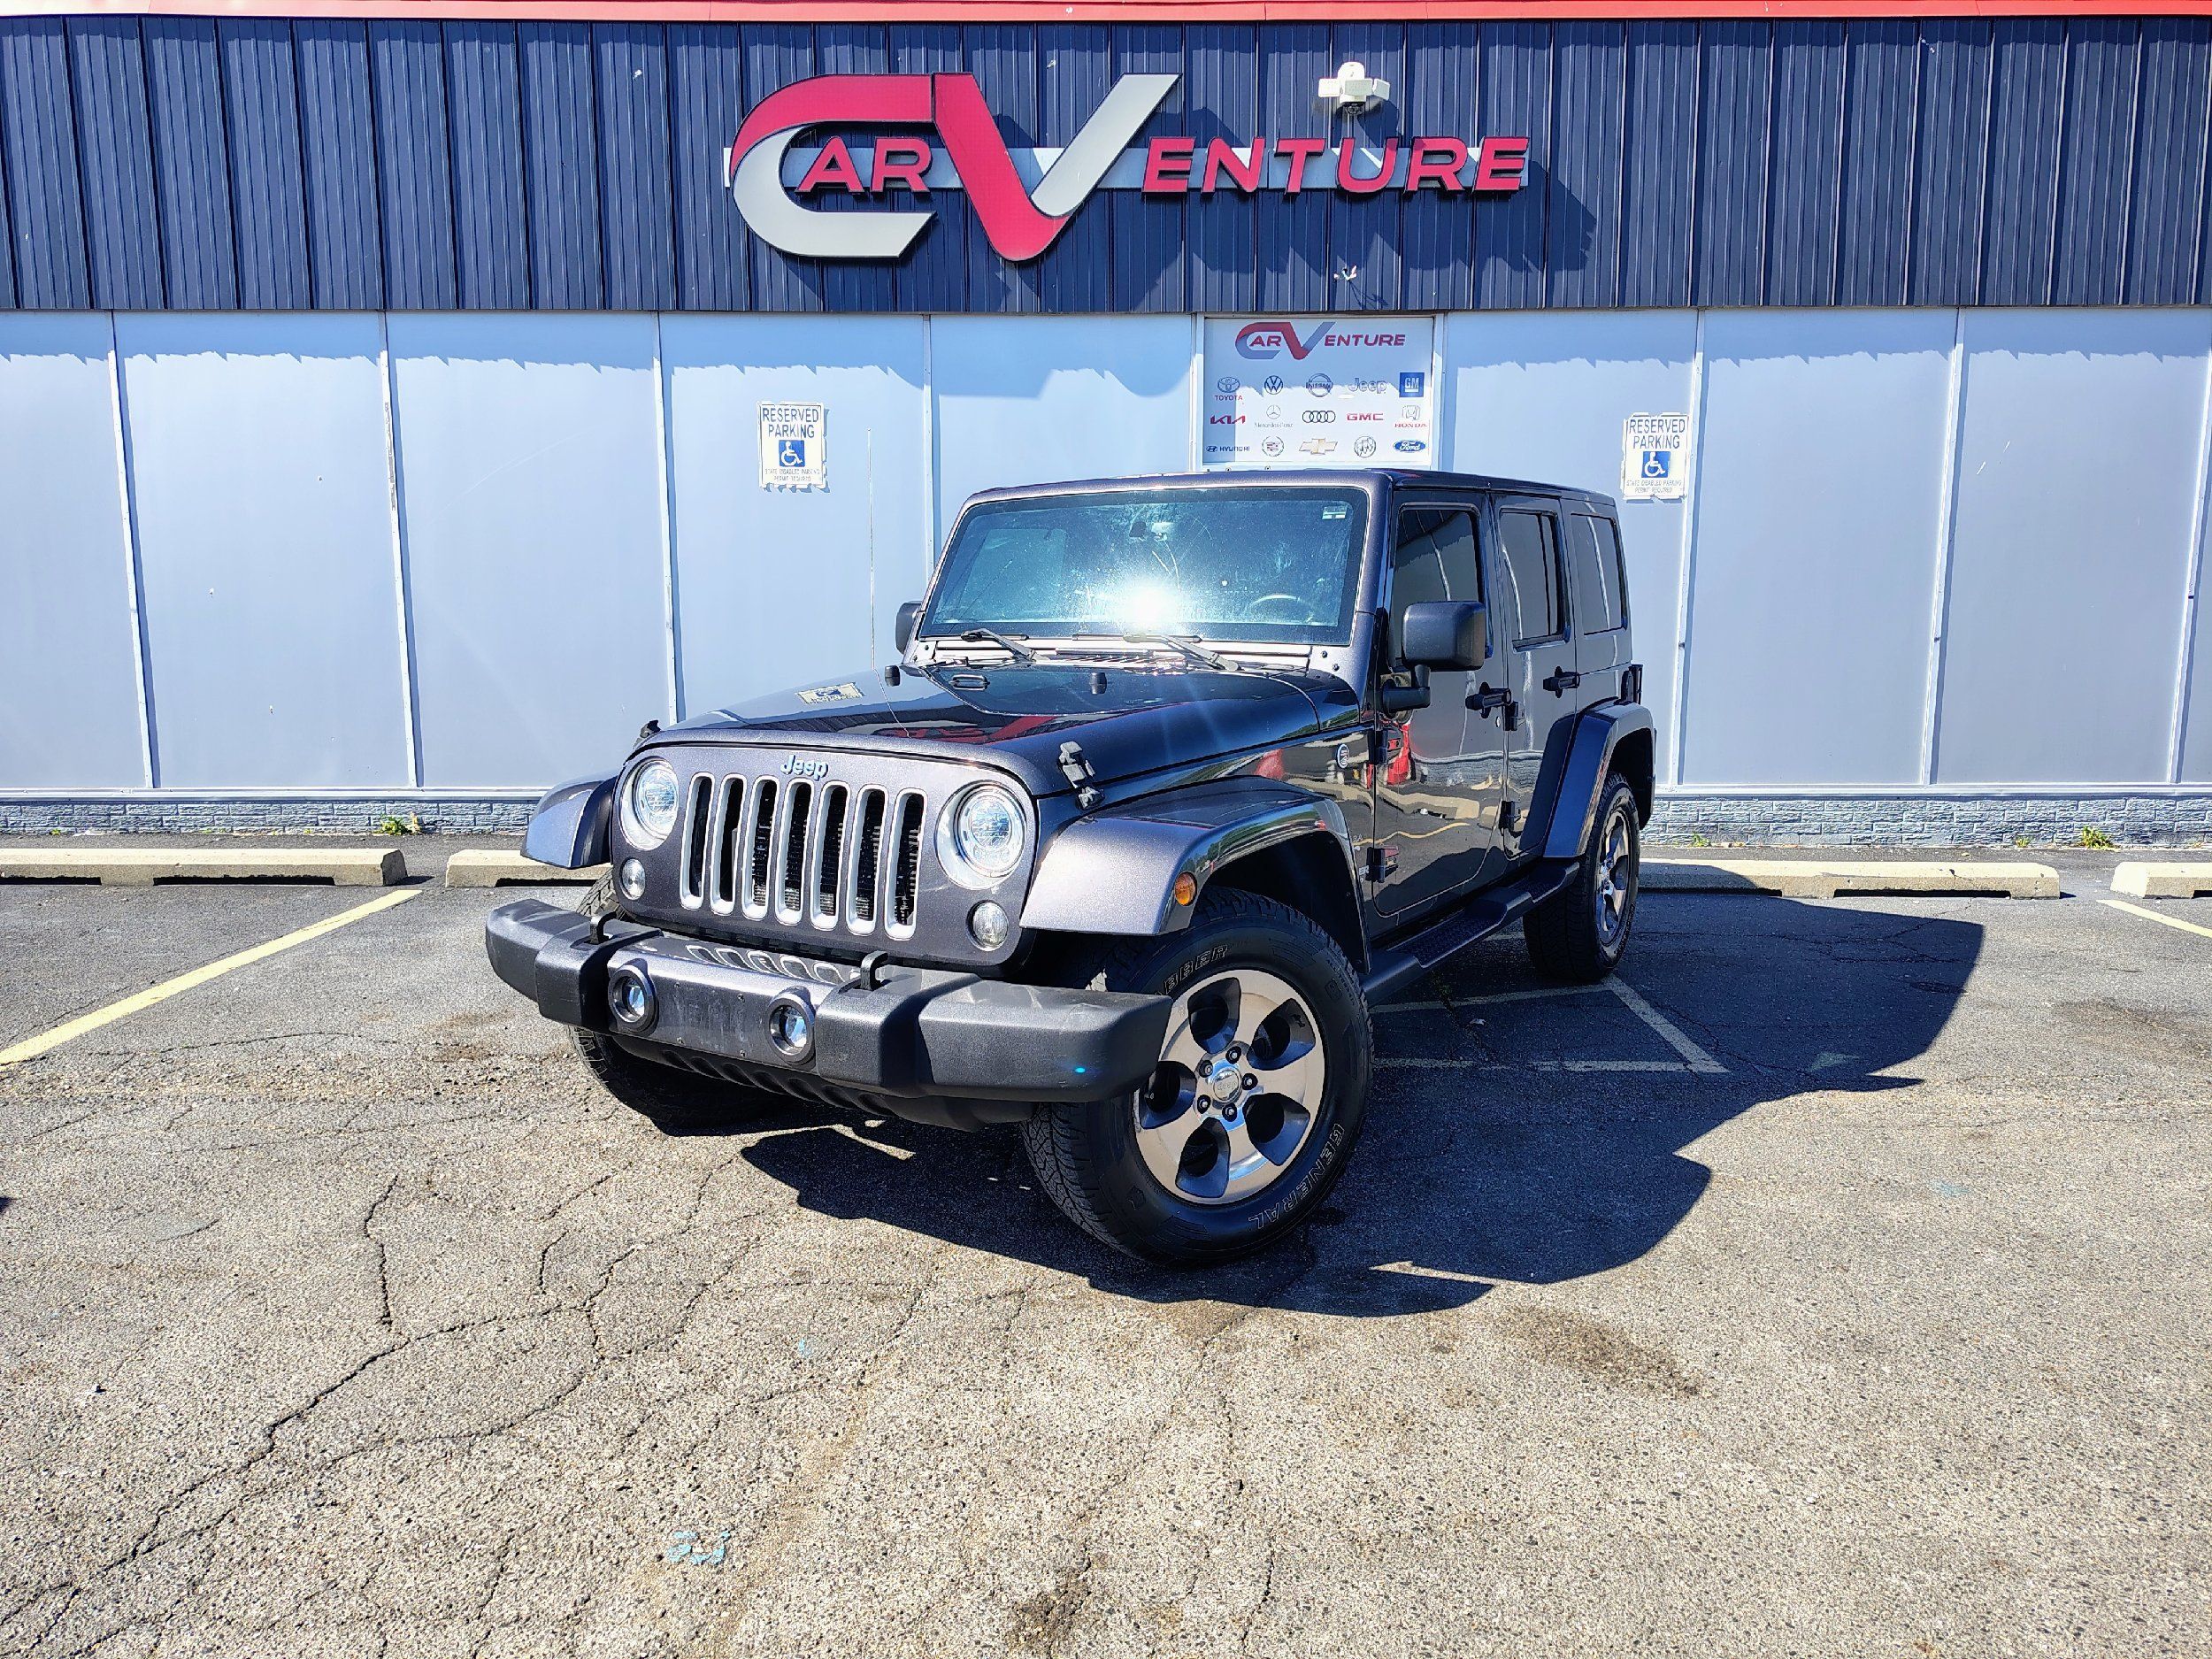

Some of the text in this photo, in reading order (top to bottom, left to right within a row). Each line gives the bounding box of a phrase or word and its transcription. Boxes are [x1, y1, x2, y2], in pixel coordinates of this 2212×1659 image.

[1348, 377, 1386, 394] Jeep
[1404, 377, 1420, 389] GM
[762, 407, 819, 423] RESERVED
[1210, 415, 1246, 425] KIA
[1346, 412, 1384, 421] GMC
[768, 423, 815, 439] PARKING
[1629, 419, 1686, 434] RESERVED
[1398, 442, 1421, 451] Ford
[1632, 434, 1680, 449] PARKING
[780, 754, 829, 782] Jeep
[1248, 1123, 1345, 1230] GENERAL
